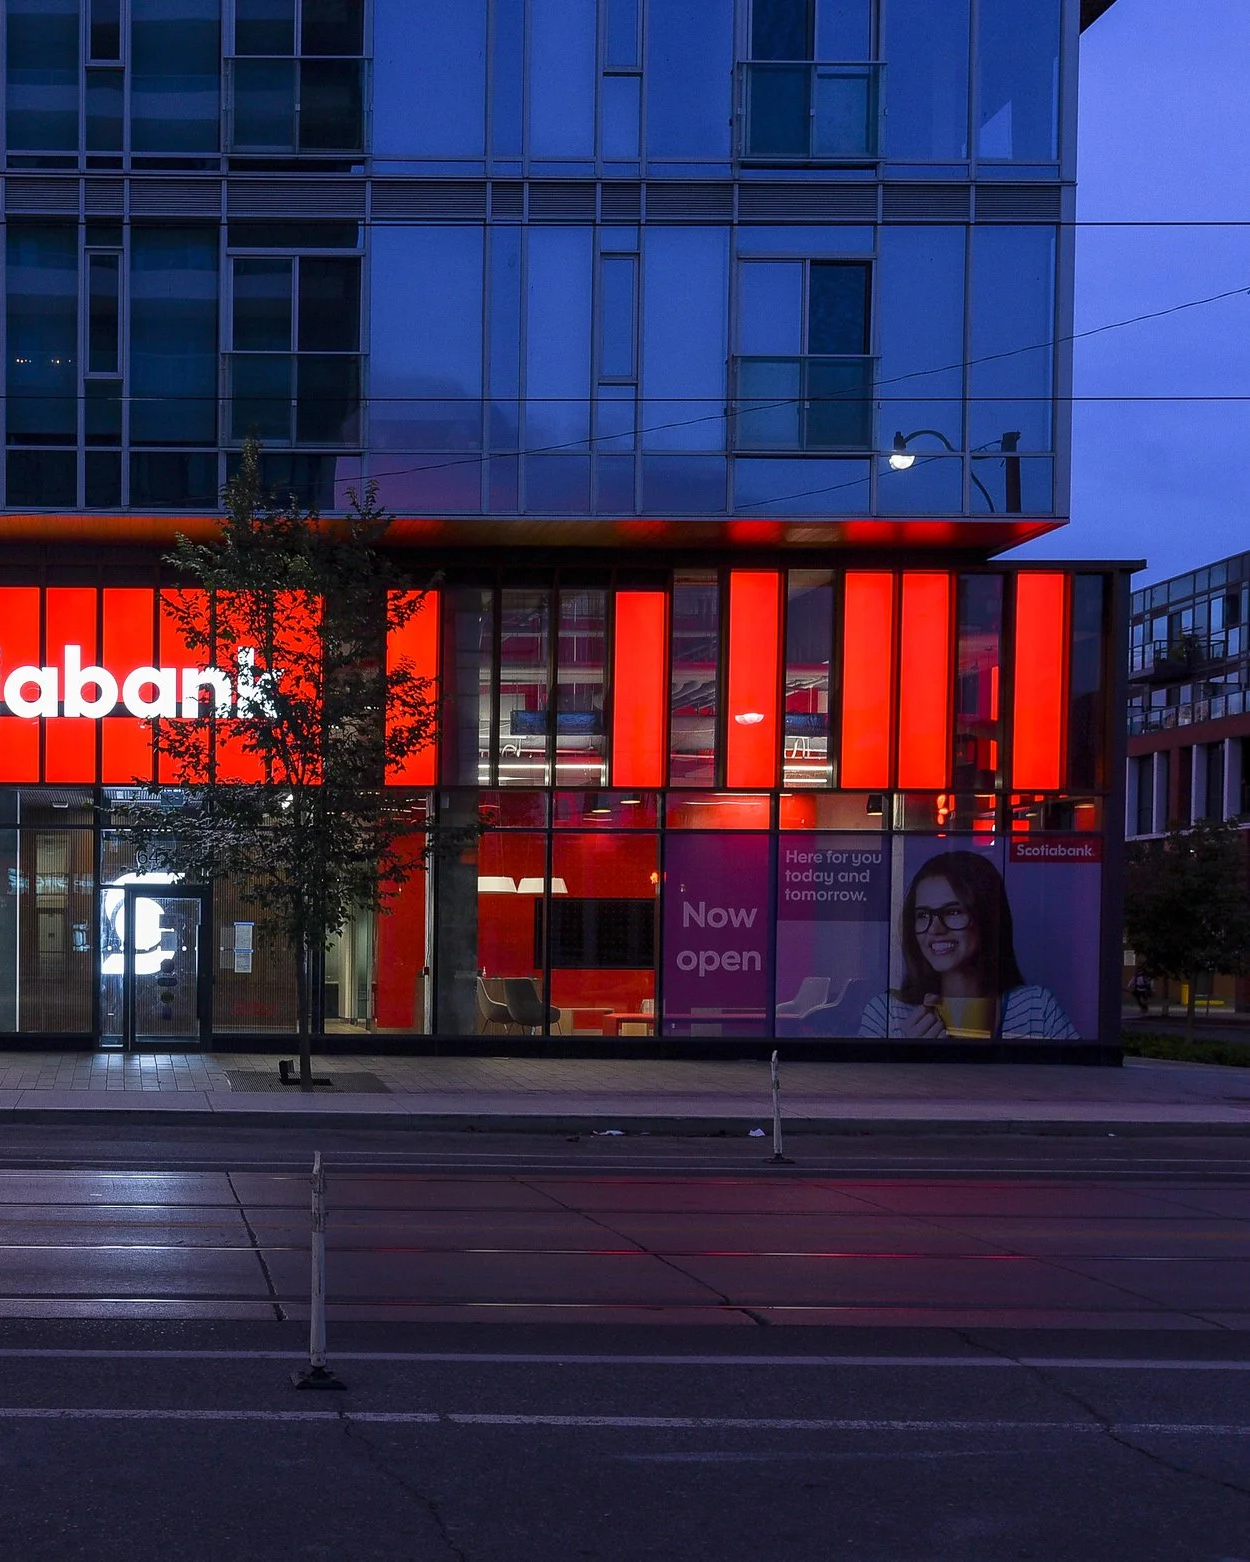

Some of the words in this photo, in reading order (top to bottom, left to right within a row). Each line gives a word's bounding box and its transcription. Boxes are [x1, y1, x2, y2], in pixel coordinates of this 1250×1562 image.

[786, 848, 821, 865] Here
[826, 848, 848, 865] for
[852, 852, 882, 868] you
[1016, 843, 1094, 858] Scotiabank
[785, 868, 834, 886] today
[838, 868, 870, 883] and
[785, 888, 867, 903] tomorrow.
[682, 900, 758, 928] Now
[676, 949, 762, 977] open
